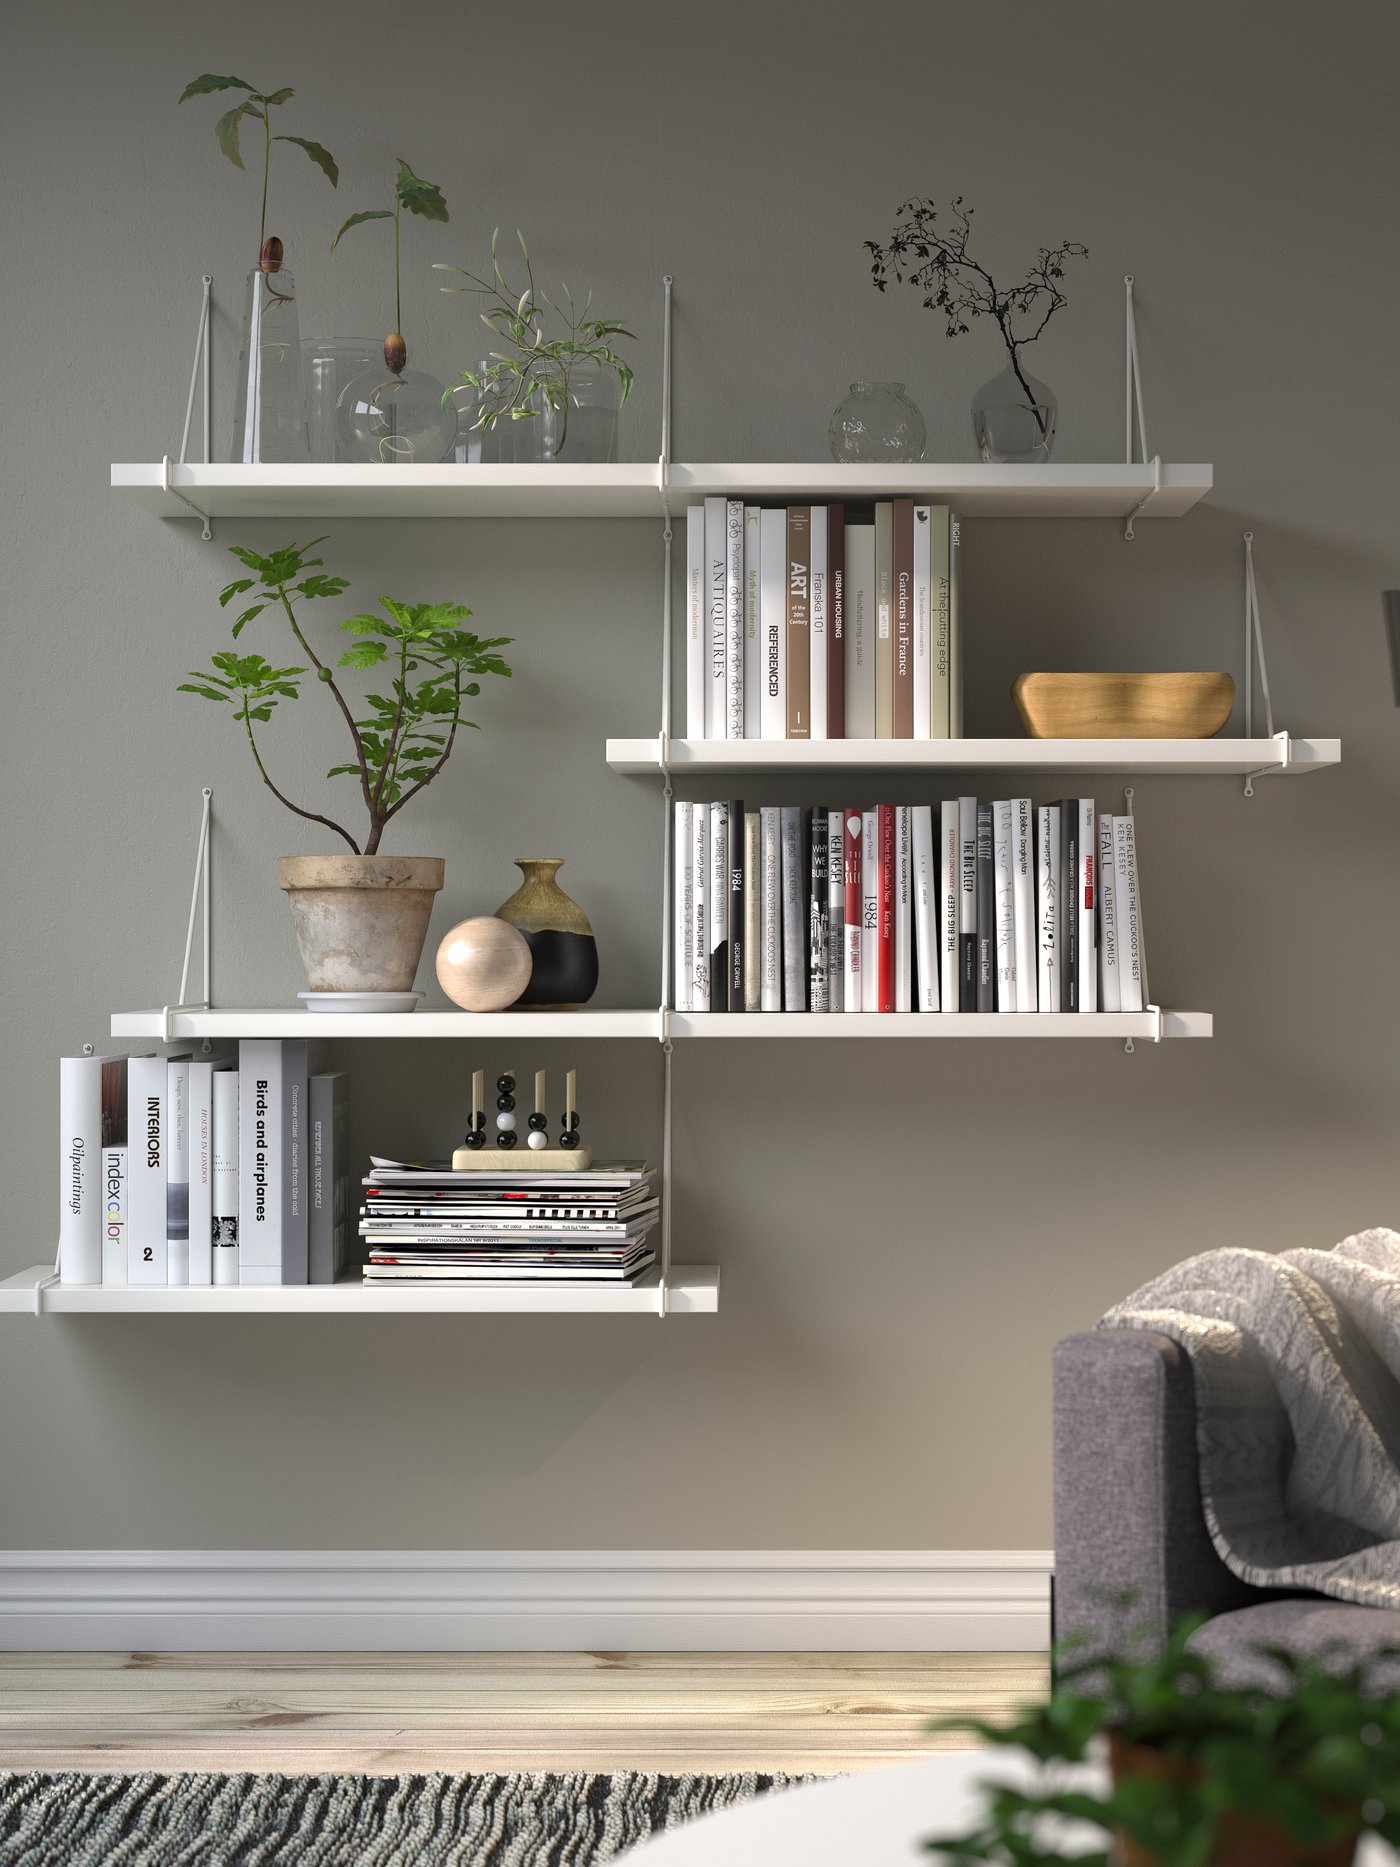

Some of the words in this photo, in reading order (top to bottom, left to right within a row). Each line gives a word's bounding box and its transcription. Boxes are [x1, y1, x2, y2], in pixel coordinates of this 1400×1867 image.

[732, 543, 741, 581] Psyclopat
[748, 570, 756, 590] Myth
[790, 562, 807, 598] ART
[834, 570, 842, 599] URBAN
[939, 576, 948, 591] At
[748, 591, 756, 599] of
[814, 572, 824, 612] Franska
[899, 572, 909, 619] Gardens
[939, 592, 948, 608] the
[711, 559, 725, 679] ANTIQUAIRES
[748, 600, 756, 639] modernity
[814, 616, 824, 634] 101
[834, 600, 842, 638] HOUSING
[899, 622, 909, 634] in
[938, 612, 948, 647] cutting
[768, 625, 779, 697] REFERENCED
[899, 636, 909, 676] France
[938, 650, 948, 677] edge
[978, 812, 991, 824] THE
[1019, 801, 1027, 815] Saul
[767, 813, 776, 826] KEN
[884, 812, 892, 825] One
[1019, 816, 1027, 836] Bellow
[767, 827, 776, 846] KESEY
[866, 820, 874, 840] George
[884, 826, 892, 838] Flew
[978, 827, 991, 838] BIG
[1125, 823, 1133, 841] ONE
[788, 843, 796, 858] ROAD
[812, 845, 828, 853] WHY
[830, 836, 842, 853] KEN
[866, 841, 874, 860] Orwell
[884, 839, 892, 852] Over
[900, 837, 908, 856] Lively
[978, 840, 991, 859] SLEEP
[1019, 839, 1027, 862] Dangling
[1101, 832, 1112, 870] FALL
[767, 854, 776, 871] ONE
[884, 853, 892, 863] the
[1126, 844, 1134, 868] FLEW
[715, 864, 724, 880] WAR
[812, 870, 828, 878] BUILD
[830, 858, 842, 884] KESEY
[1019, 863, 1027, 875] Man
[1084, 855, 1093, 886] FRANÇOIS
[732, 868, 742, 891] 1984
[767, 872, 776, 891] FLEW
[684, 884, 693, 911] YEARS
[767, 892, 776, 912] OVER
[884, 890, 892, 903] Nest
[948, 895, 956, 917] SLEEP
[1104, 886, 1113, 926] ALBERT
[684, 914, 693, 926] OF
[767, 912, 776, 925] THE
[864, 894, 877, 930] 1984
[884, 910, 892, 922] Ken
[884, 923, 892, 938] Kesey
[948, 920, 956, 934] BIG
[1130, 914, 1138, 957] CUCKOO'S
[684, 930, 693, 967] SOLITUDE
[948, 937, 956, 952] THE
[980, 939, 990, 962] Raymond
[1106, 930, 1115, 966] CAMUS
[767, 964, 776, 982] NEST
[980, 963, 990, 985] Chandler
[256, 1080, 268, 1117] Birds
[147, 1097, 160, 1168] INTERIORS
[200, 1109, 208, 1139] HOUSES
[176, 1129, 184, 1151] forever
[256, 1120, 268, 1149] and
[314, 1121, 322, 1154] REMEMBER
[200, 1141, 208, 1150] IN
[200, 1152, 208, 1184] LONDON
[314, 1155, 322, 1166] ALL
[69, 1137, 85, 1215] Oilpaintings
[107, 1153, 124, 1200] index
[314, 1167, 322, 1188] THOSE
[254, 1152, 268, 1222] airplanes
[314, 1189, 322, 1209] FACES
[107, 1202, 124, 1245] color
[143, 1247, 153, 1262] 2
